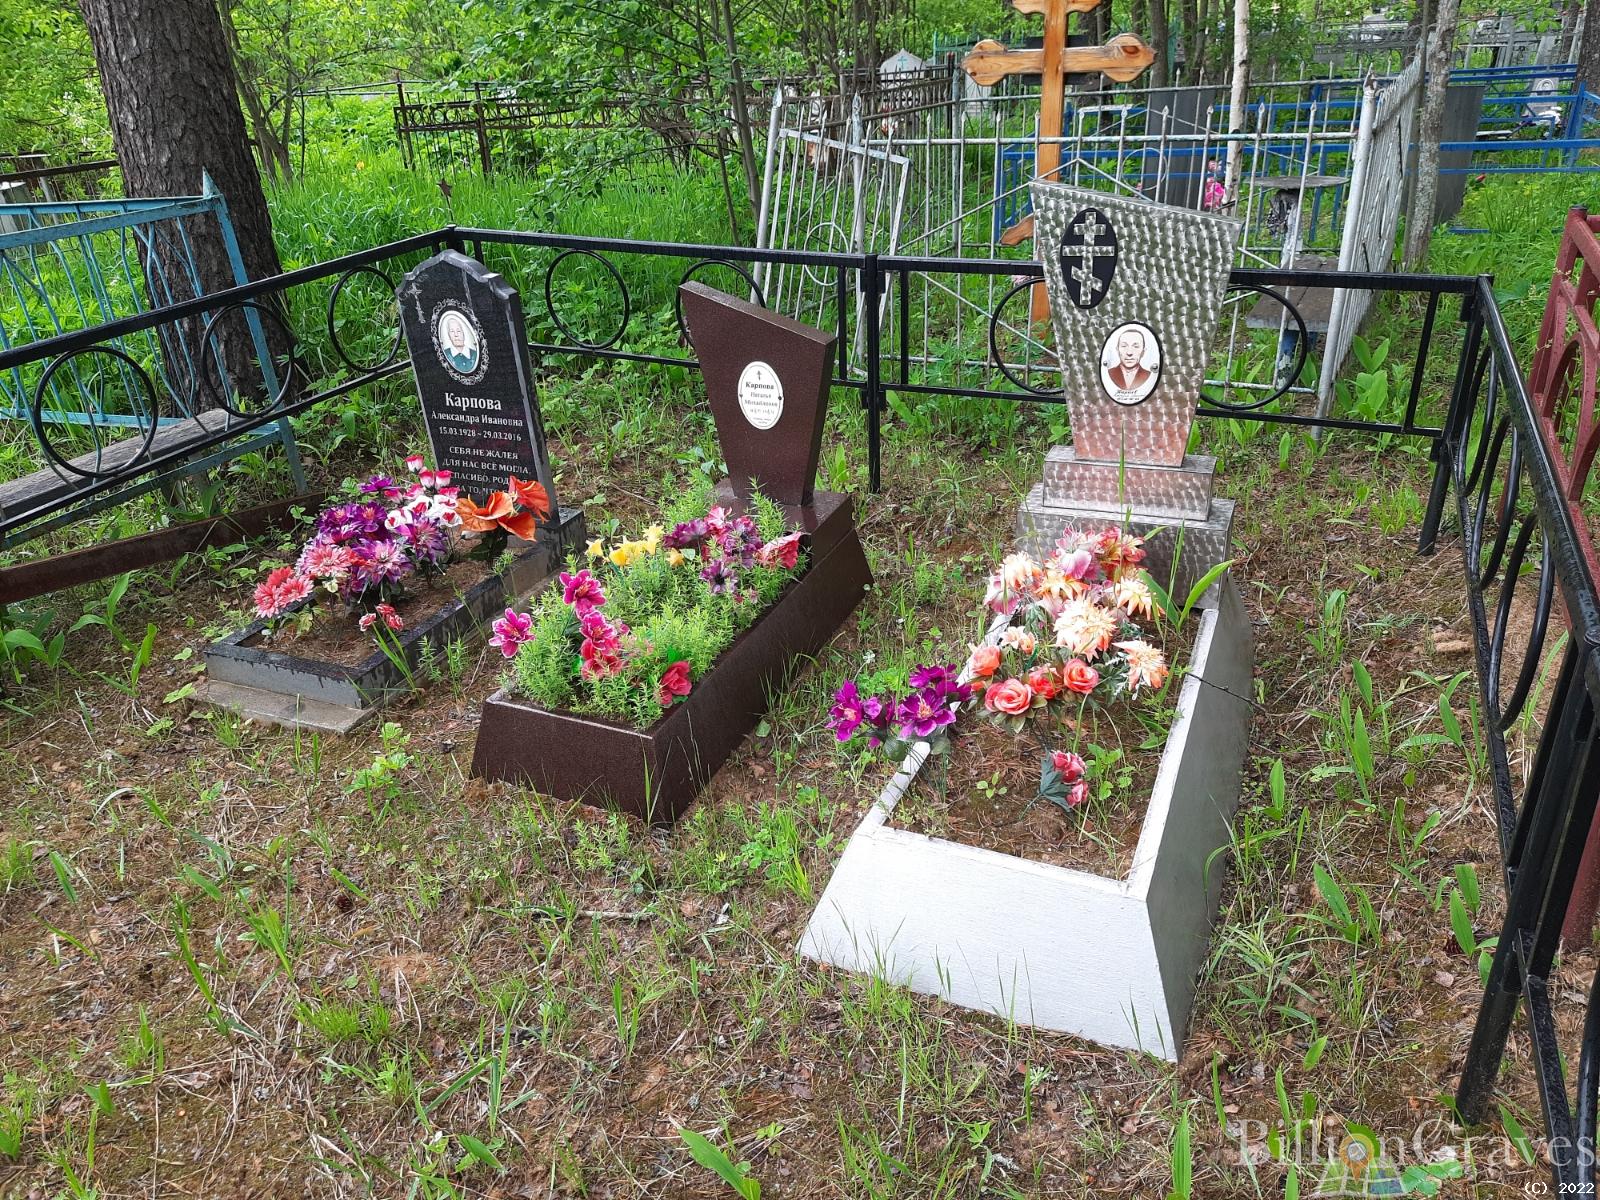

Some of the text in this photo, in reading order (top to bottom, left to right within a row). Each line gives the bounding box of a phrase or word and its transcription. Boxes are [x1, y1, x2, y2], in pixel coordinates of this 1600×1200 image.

[745, 381, 774, 390] Карпова
[445, 392, 501, 410] Карпова
[431, 410, 523, 427] Александра Ивановна
[449, 446, 518, 460] СЕБЯ НЕ ЖАЛЕЯ
[442, 458, 460, 467] ДЛЯ
[462, 460, 479, 469] НАС
